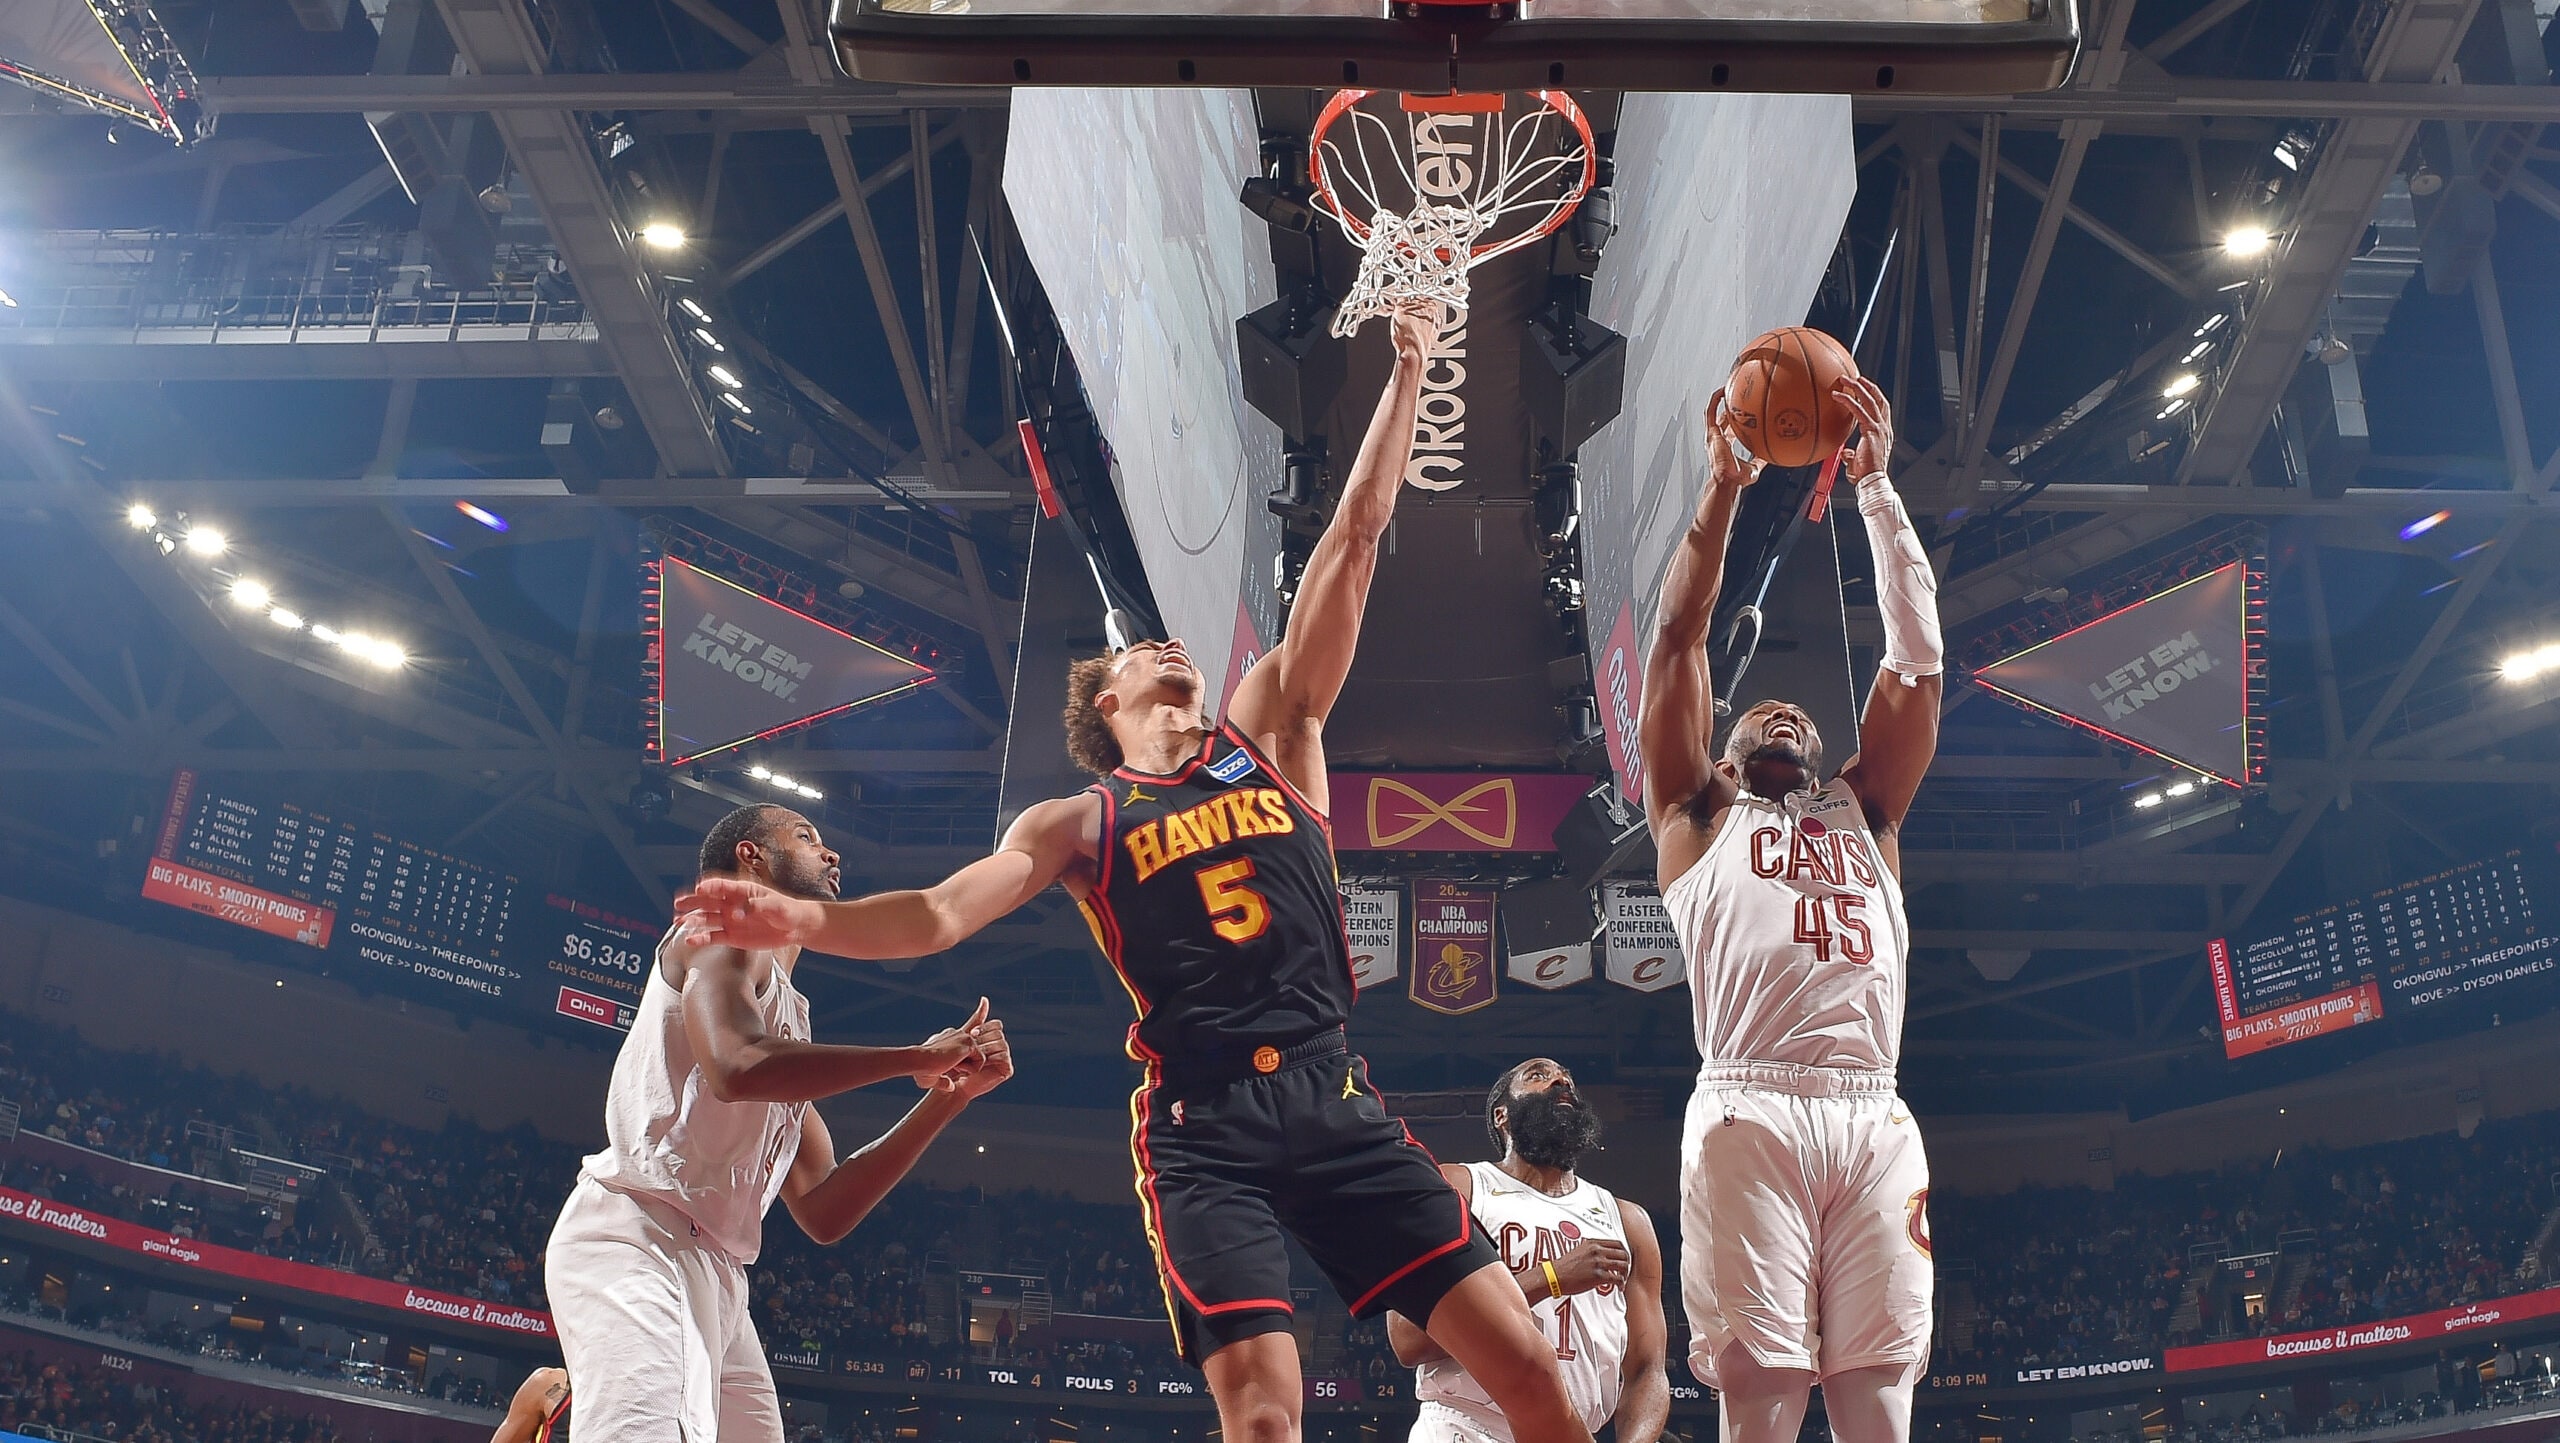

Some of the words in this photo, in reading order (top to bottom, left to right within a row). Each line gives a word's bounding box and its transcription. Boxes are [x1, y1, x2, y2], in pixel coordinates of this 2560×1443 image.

[697, 613, 763, 652] LET
[760, 646, 813, 680] EM
[682, 632, 798, 703] KNOW.
[2088, 657, 2145, 700] LET
[2149, 630, 2200, 669] EM
[219, 798, 258, 816] HARDEN
[1808, 799, 1850, 814] CLIFFS
[216, 810, 248, 826] STRUS
[192, 828, 203, 838] 31
[209, 834, 240, 849] ALLEN
[213, 821, 253, 840] MOBLEY
[1123, 788, 1296, 884] HAWKS
[207, 846, 253, 867] MITCHELL
[1750, 826, 1877, 889] CAVS
[151, 866, 172, 883] BIG
[218, 886, 265, 910] SMOOTH
[268, 900, 307, 923] POURS
[1195, 856, 1273, 944] 5
[1441, 905, 1467, 920] NBA
[1418, 919, 1489, 935] CHAMPIONS
[1609, 920, 1675, 933] CONFERENC
[1792, 893, 1876, 966] 45
[1613, 937, 1681, 949] CHAMPIONS
[2247, 935, 2285, 953] JOHNSON
[563, 933, 642, 974] $6,343
[2249, 944, 2294, 964] MCCOLLUM
[414, 962, 453, 982] DYSON
[2251, 959, 2284, 975] DANIELS
[2211, 943, 2228, 987] ATLANTA
[2220, 987, 2234, 1021] HAWKS
[2255, 979, 2297, 996] OKONGWU
[2463, 972, 2503, 992] DYSON
[570, 998, 605, 1017] Ohio
[2226, 1028, 2243, 1042] BIG
[2279, 1006, 2319, 1027] SMOOTH
[2320, 995, 2355, 1016] POURS
[2286, 1019, 2322, 1040] Tito's
[1257, 1053, 1277, 1065] ATL
[26, 1199, 42, 1220] it
[41, 1209, 107, 1238] matters
[142, 1239, 170, 1254] giant
[170, 1244, 200, 1261] eagle
[405, 1290, 469, 1318] because
[472, 1303, 487, 1321] it
[486, 1312, 547, 1332] matters
[2445, 1314, 2471, 1331] giant
[2471, 1308, 2500, 1326] eagle
[1554, 1296, 1577, 1361] 1
[2266, 1336, 2333, 1357] because
[2335, 1330, 2349, 1348] it
[2350, 1324, 2411, 1347] matters
[101, 1353, 133, 1371] M124
[774, 1352, 819, 1366] oswald
[845, 1360, 885, 1374] $6,343
[939, 1367, 961, 1380] -11
[988, 1370, 1018, 1385] TOL
[1031, 1373, 1041, 1387] 4
[2017, 1369, 2054, 1383] LET
[2057, 1366, 2086, 1379] EM
[2088, 1357, 2154, 1376] KNOW.
[1065, 1376, 1114, 1391] FOULS
[1127, 1380, 1138, 1393] 3
[1159, 1381, 1193, 1394] FG%
[1314, 1382, 1337, 1397] 56
[1377, 1385, 1395, 1397] 24
[1932, 1376, 1961, 1388] 8:09
[1966, 1373, 1987, 1386] PM
